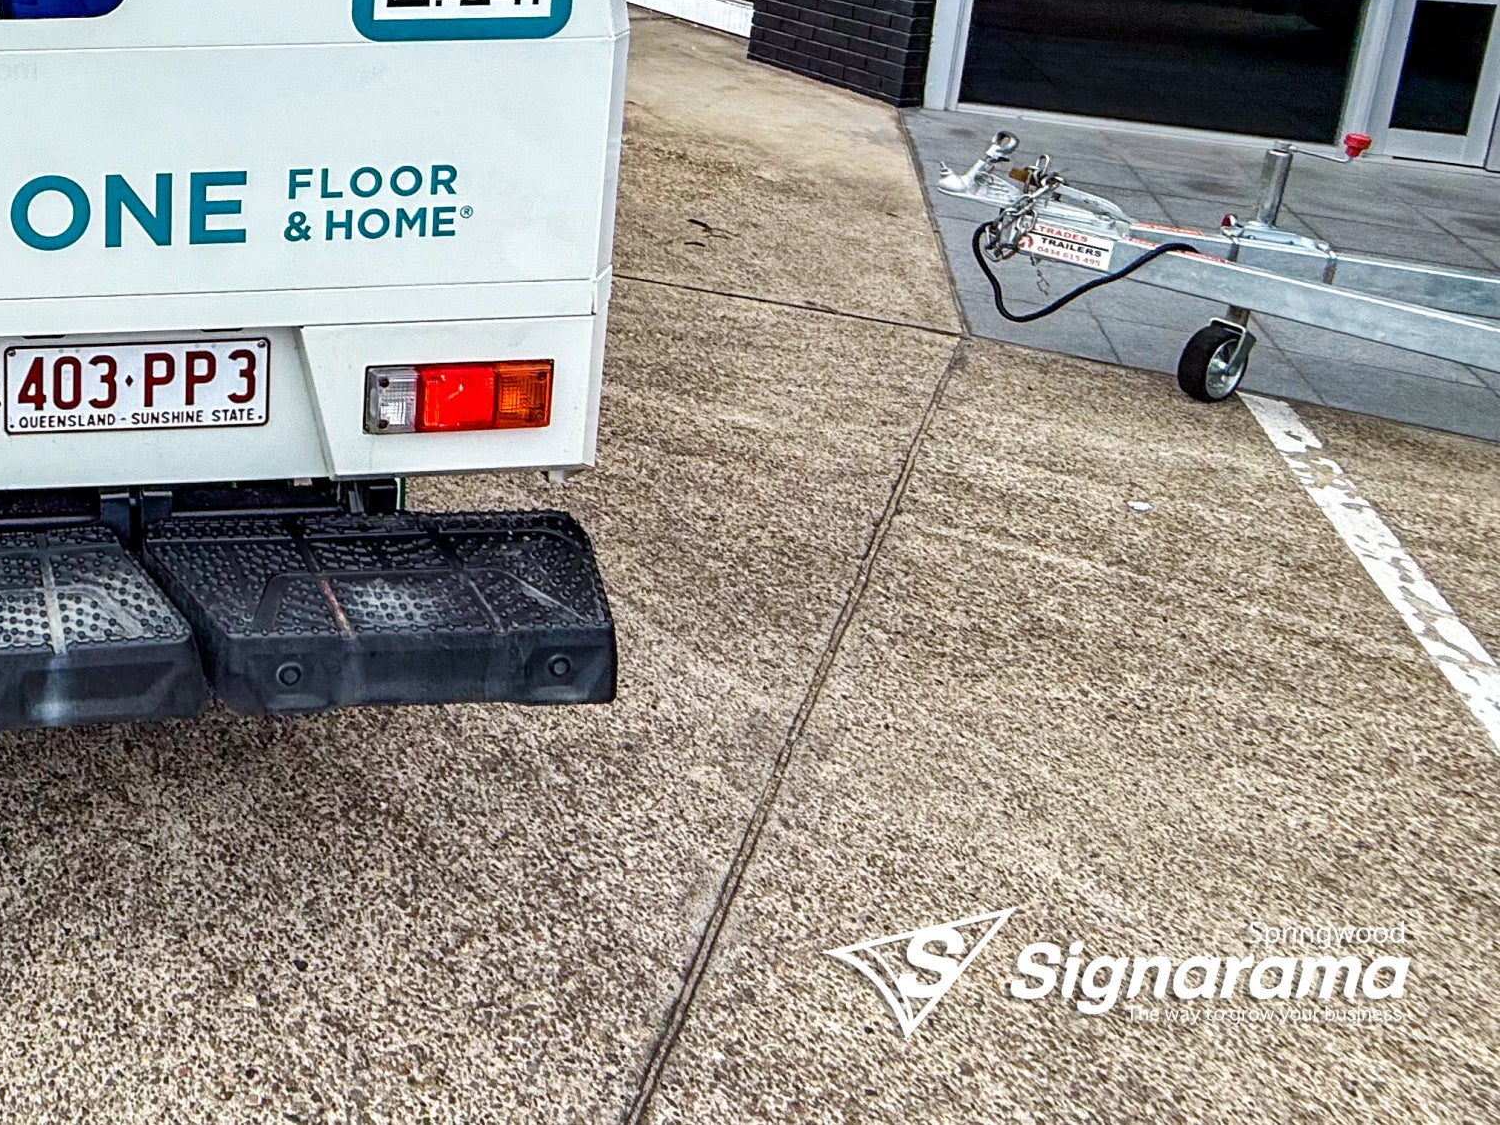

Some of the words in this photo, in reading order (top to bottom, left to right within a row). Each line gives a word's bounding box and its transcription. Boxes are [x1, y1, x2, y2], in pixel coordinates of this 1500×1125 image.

[288, 164, 458, 200] FLOOR
[10, 170, 248, 251] ONE
[283, 211, 312, 242] &
[1040, 236, 1102, 258] TRAILERS
[18, 412, 116, 430] QUEENSLAND
[131, 409, 203, 426] SUNSHINE
[211, 407, 255, 423] STATE
